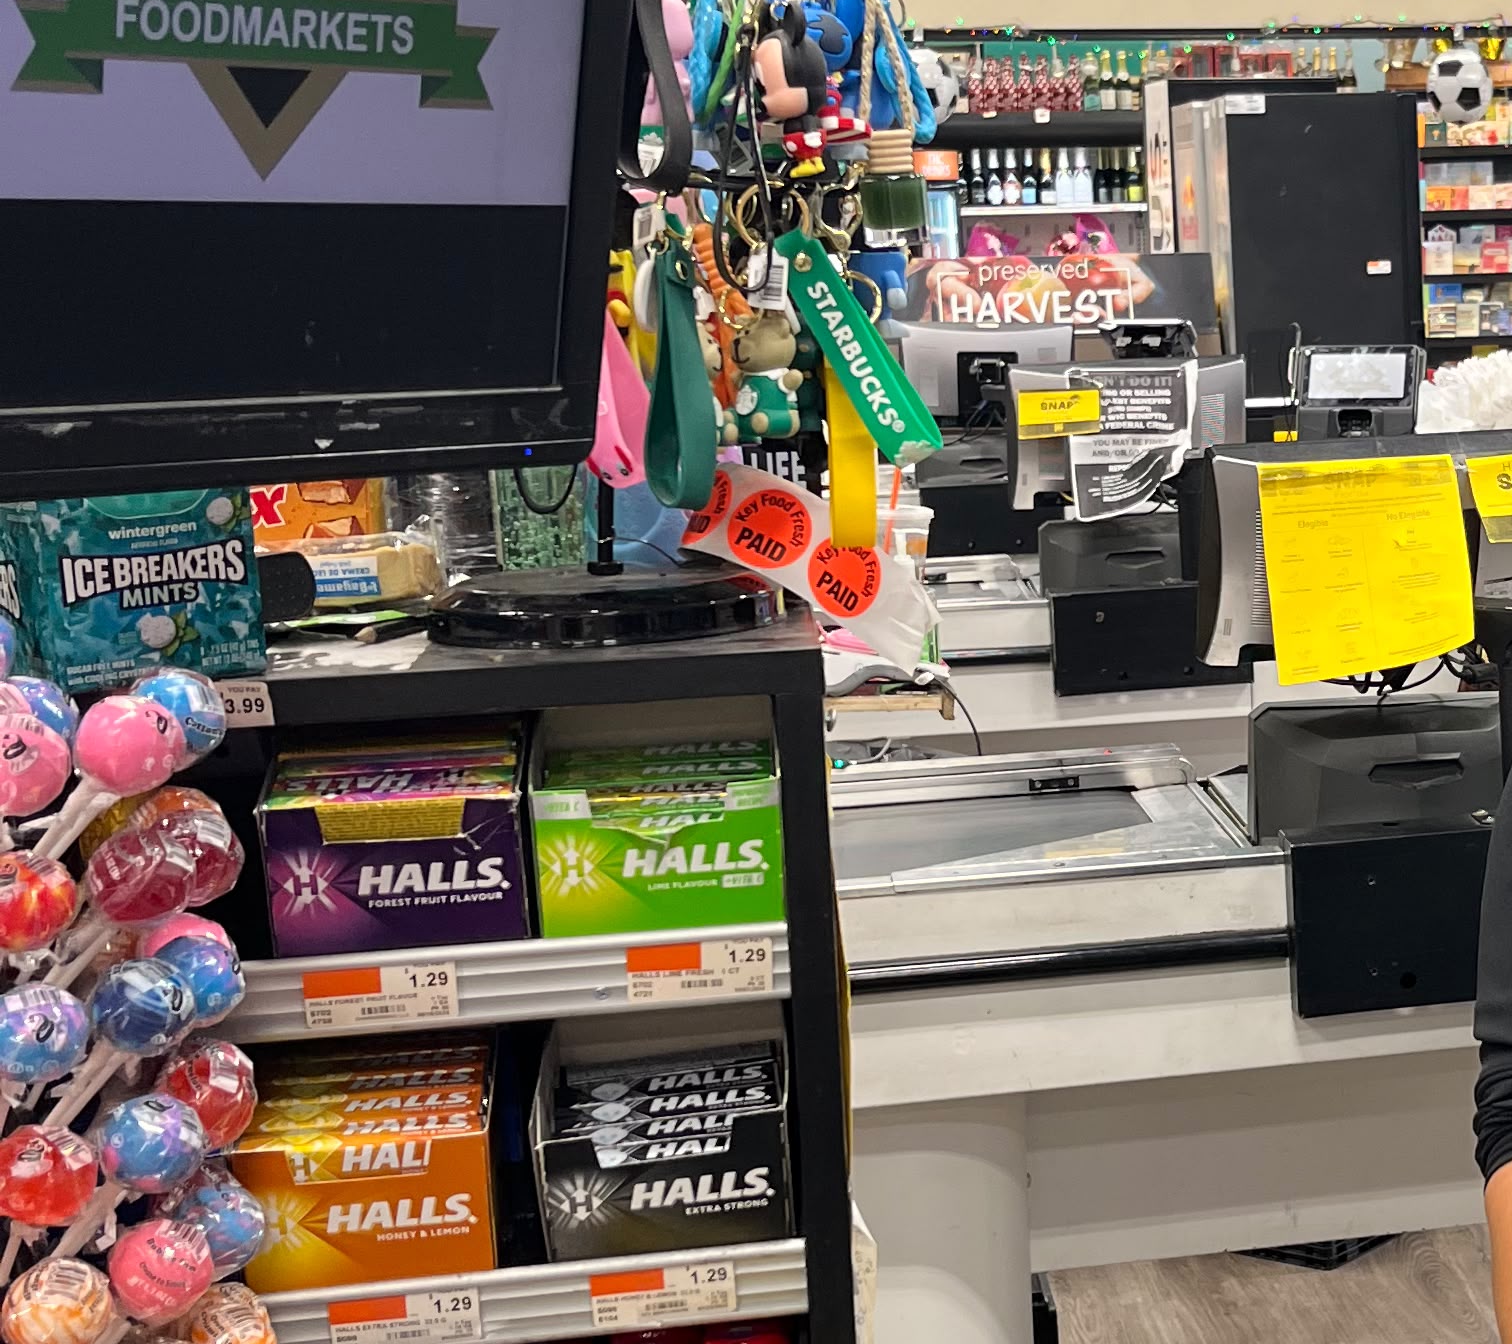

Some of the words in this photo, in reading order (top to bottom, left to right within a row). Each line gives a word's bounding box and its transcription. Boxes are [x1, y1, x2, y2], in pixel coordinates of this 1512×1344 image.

[978, 258, 1089, 287] preserved
[950, 288, 1122, 324] HARVEST
[807, 281, 899, 432] STARBUCKS
[108, 522, 197, 540] wintergreen
[735, 500, 759, 522] Key
[761, 493, 796, 512] Food
[790, 510, 805, 547] Fresh
[734, 527, 787, 562] PAID
[62, 558, 111, 604] ICE
[112, 539, 246, 589] BREAKERS
[865, 559, 877, 598] Fresh
[122, 582, 198, 608] MINTS
[816, 570, 859, 612] PAID
[225, 697, 265, 714] 3.99
[369, 898, 412, 908] FOREST
[414, 895, 447, 905] FRUIT
[450, 891, 503, 903] FLAVOUR
[729, 948, 766, 963] 1.29
[409, 971, 448, 988] 1.29
[341, 1140, 431, 1173] HAL
[685, 1204, 721, 1216] EXTRA
[724, 1198, 769, 1211] STRONG
[377, 1230, 416, 1242] HONEY
[430, 1226, 470, 1237] LEMON
[691, 1267, 728, 1284] 1.29
[434, 1296, 472, 1313] 1.29
